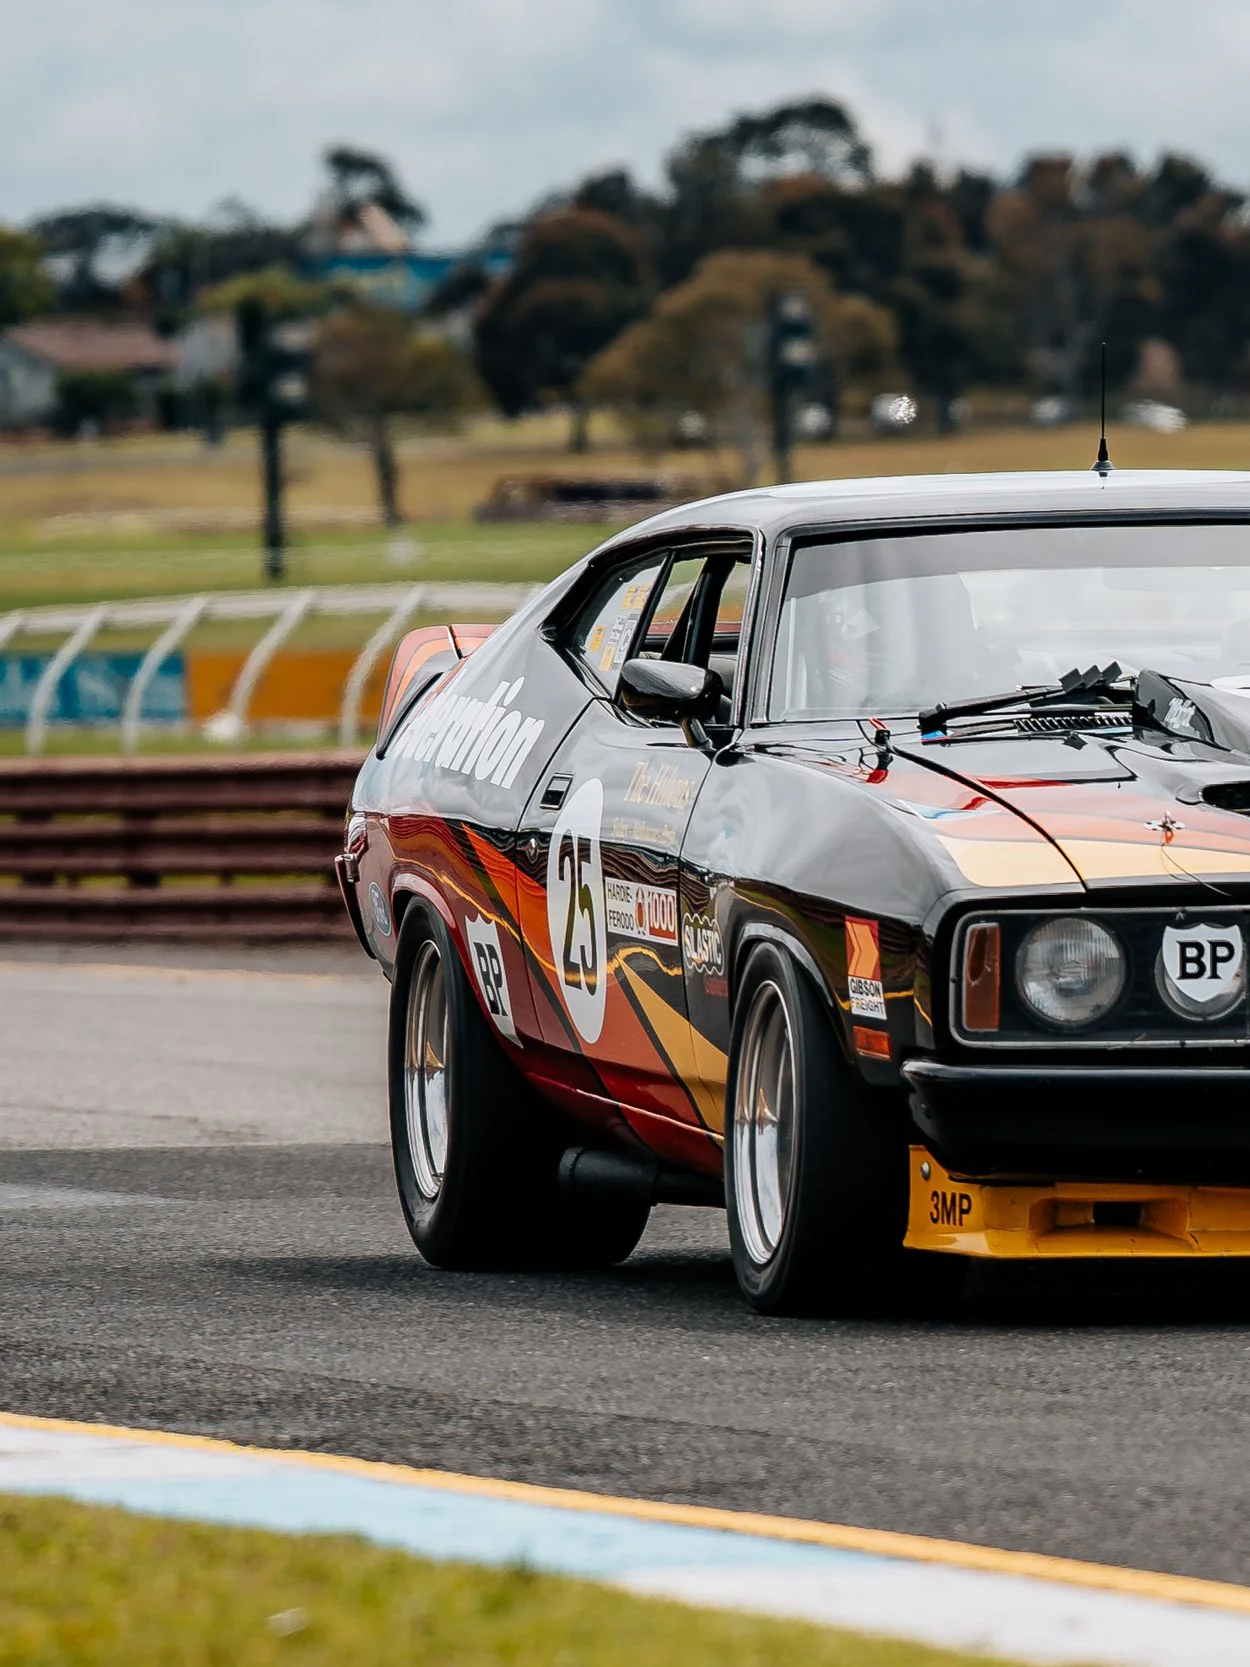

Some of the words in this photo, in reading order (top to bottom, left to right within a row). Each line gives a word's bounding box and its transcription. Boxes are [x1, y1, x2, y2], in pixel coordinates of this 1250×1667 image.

[558, 828, 598, 997] 25
[608, 908, 635, 932] FERODO
[647, 889, 675, 933] 1000
[473, 941, 509, 1016] BP
[1175, 939, 1236, 980] BP
[850, 978, 881, 997] GIBSON
[851, 997, 885, 1014] FREIGHT
[929, 1189, 973, 1227] 3MP
